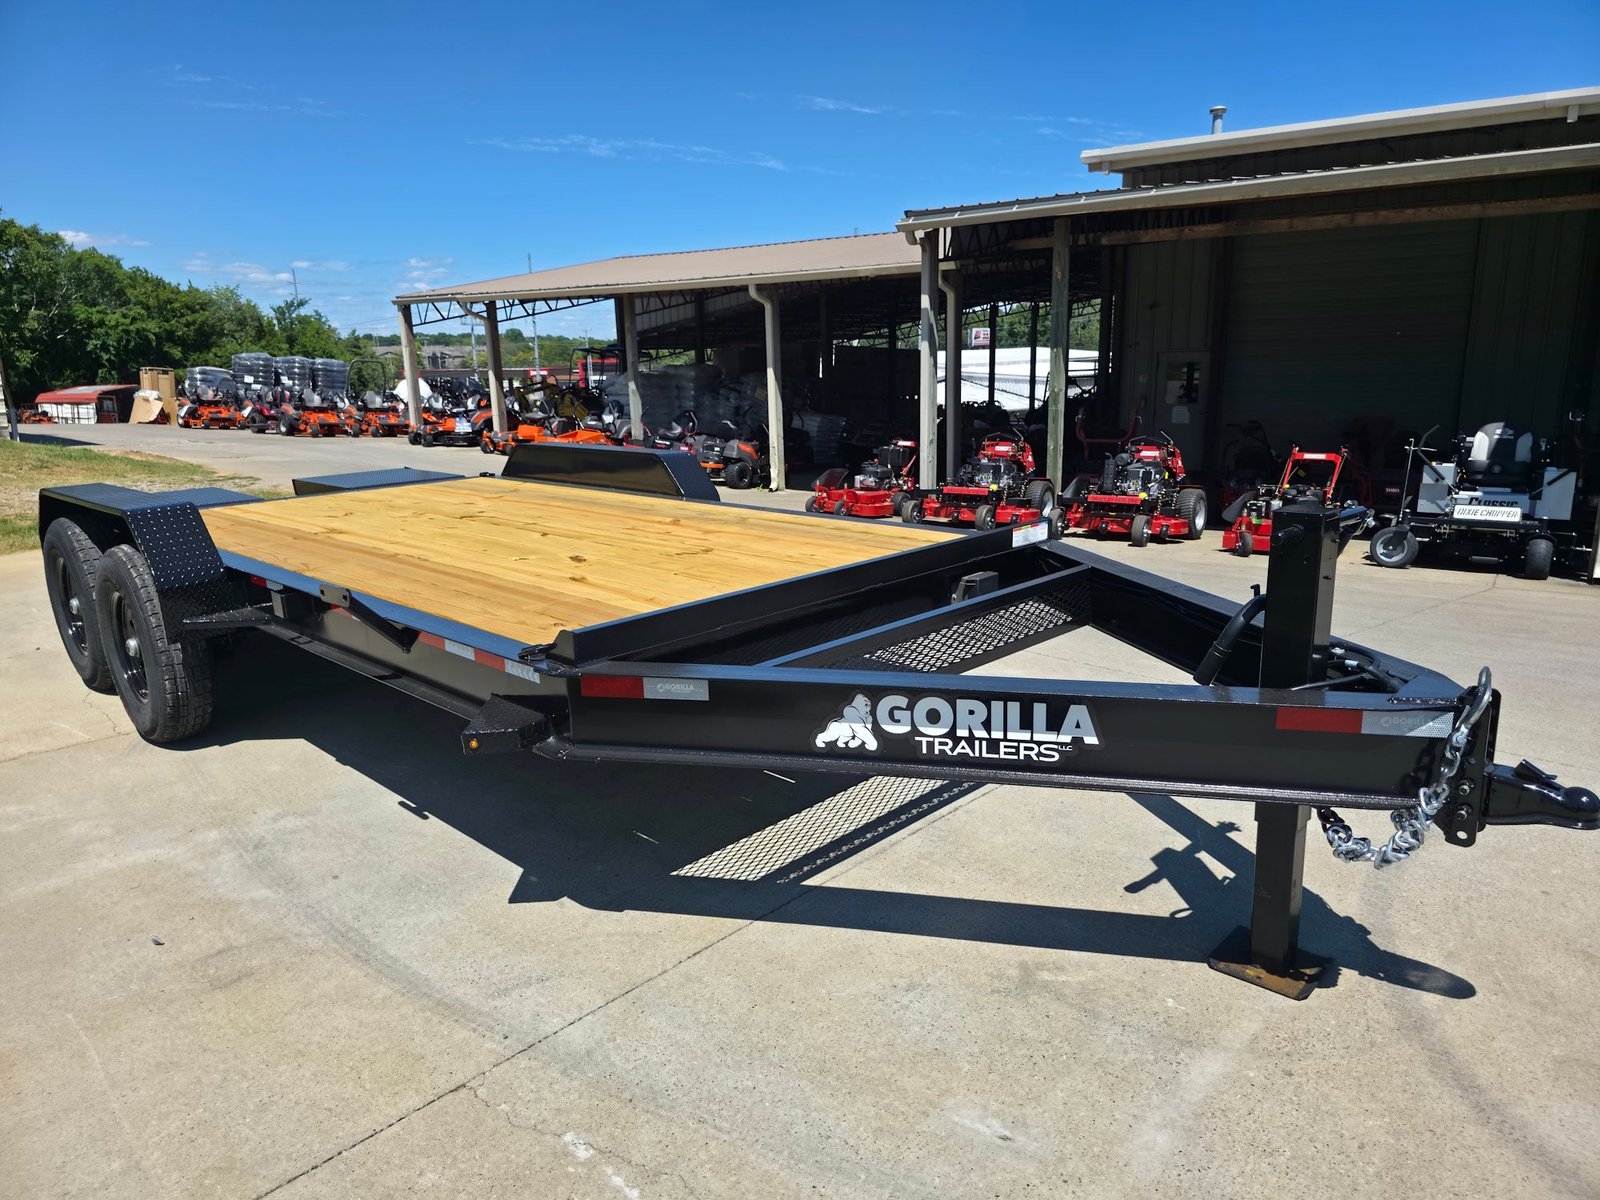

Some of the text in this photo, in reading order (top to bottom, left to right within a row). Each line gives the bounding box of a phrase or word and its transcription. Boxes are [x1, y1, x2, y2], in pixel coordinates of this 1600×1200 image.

[1456, 508, 1519, 518] DIXIE CHOPPER
[665, 683, 694, 691] GORILLA
[876, 694, 1099, 745] GORILLA
[915, 736, 1060, 762] TRAILERS
